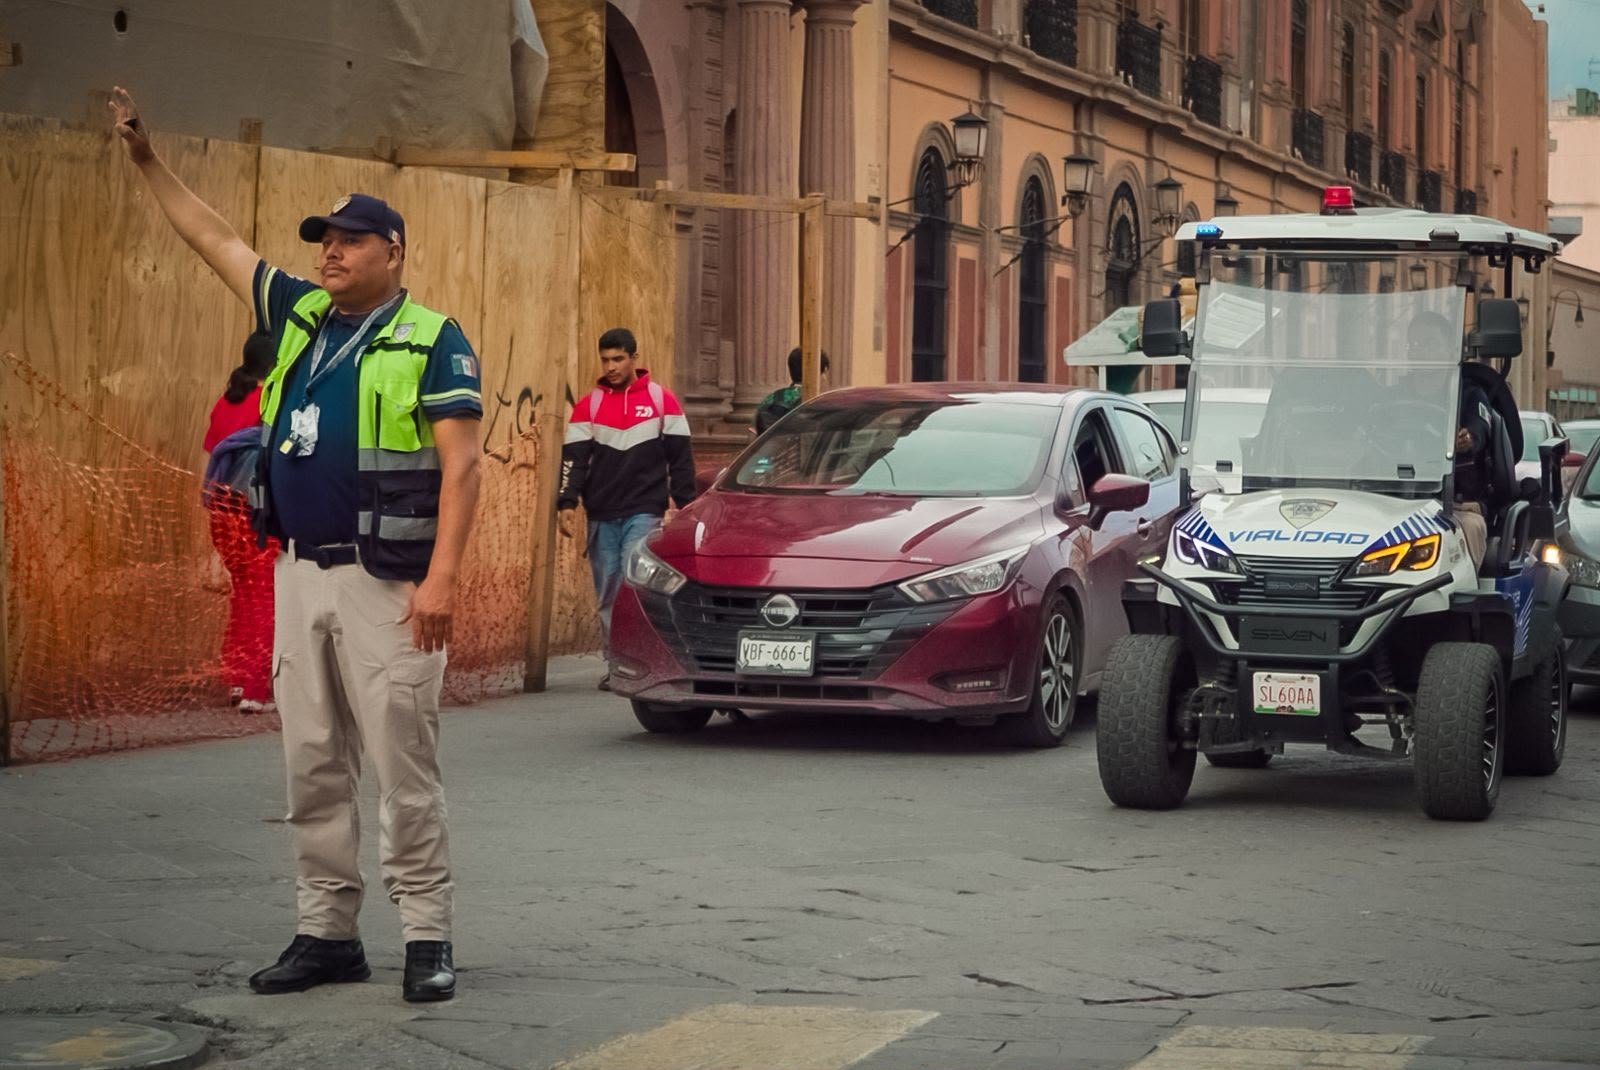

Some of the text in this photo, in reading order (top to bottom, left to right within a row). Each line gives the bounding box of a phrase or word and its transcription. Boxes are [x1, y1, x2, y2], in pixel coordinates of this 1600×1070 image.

[1229, 529, 1370, 545] VIALIDAD
[1266, 581, 1317, 591] SEVEN
[1251, 628, 1327, 643] SEVEN
[742, 642, 811, 662] VBF-666-C
[1259, 685, 1314, 705] SL60AA
